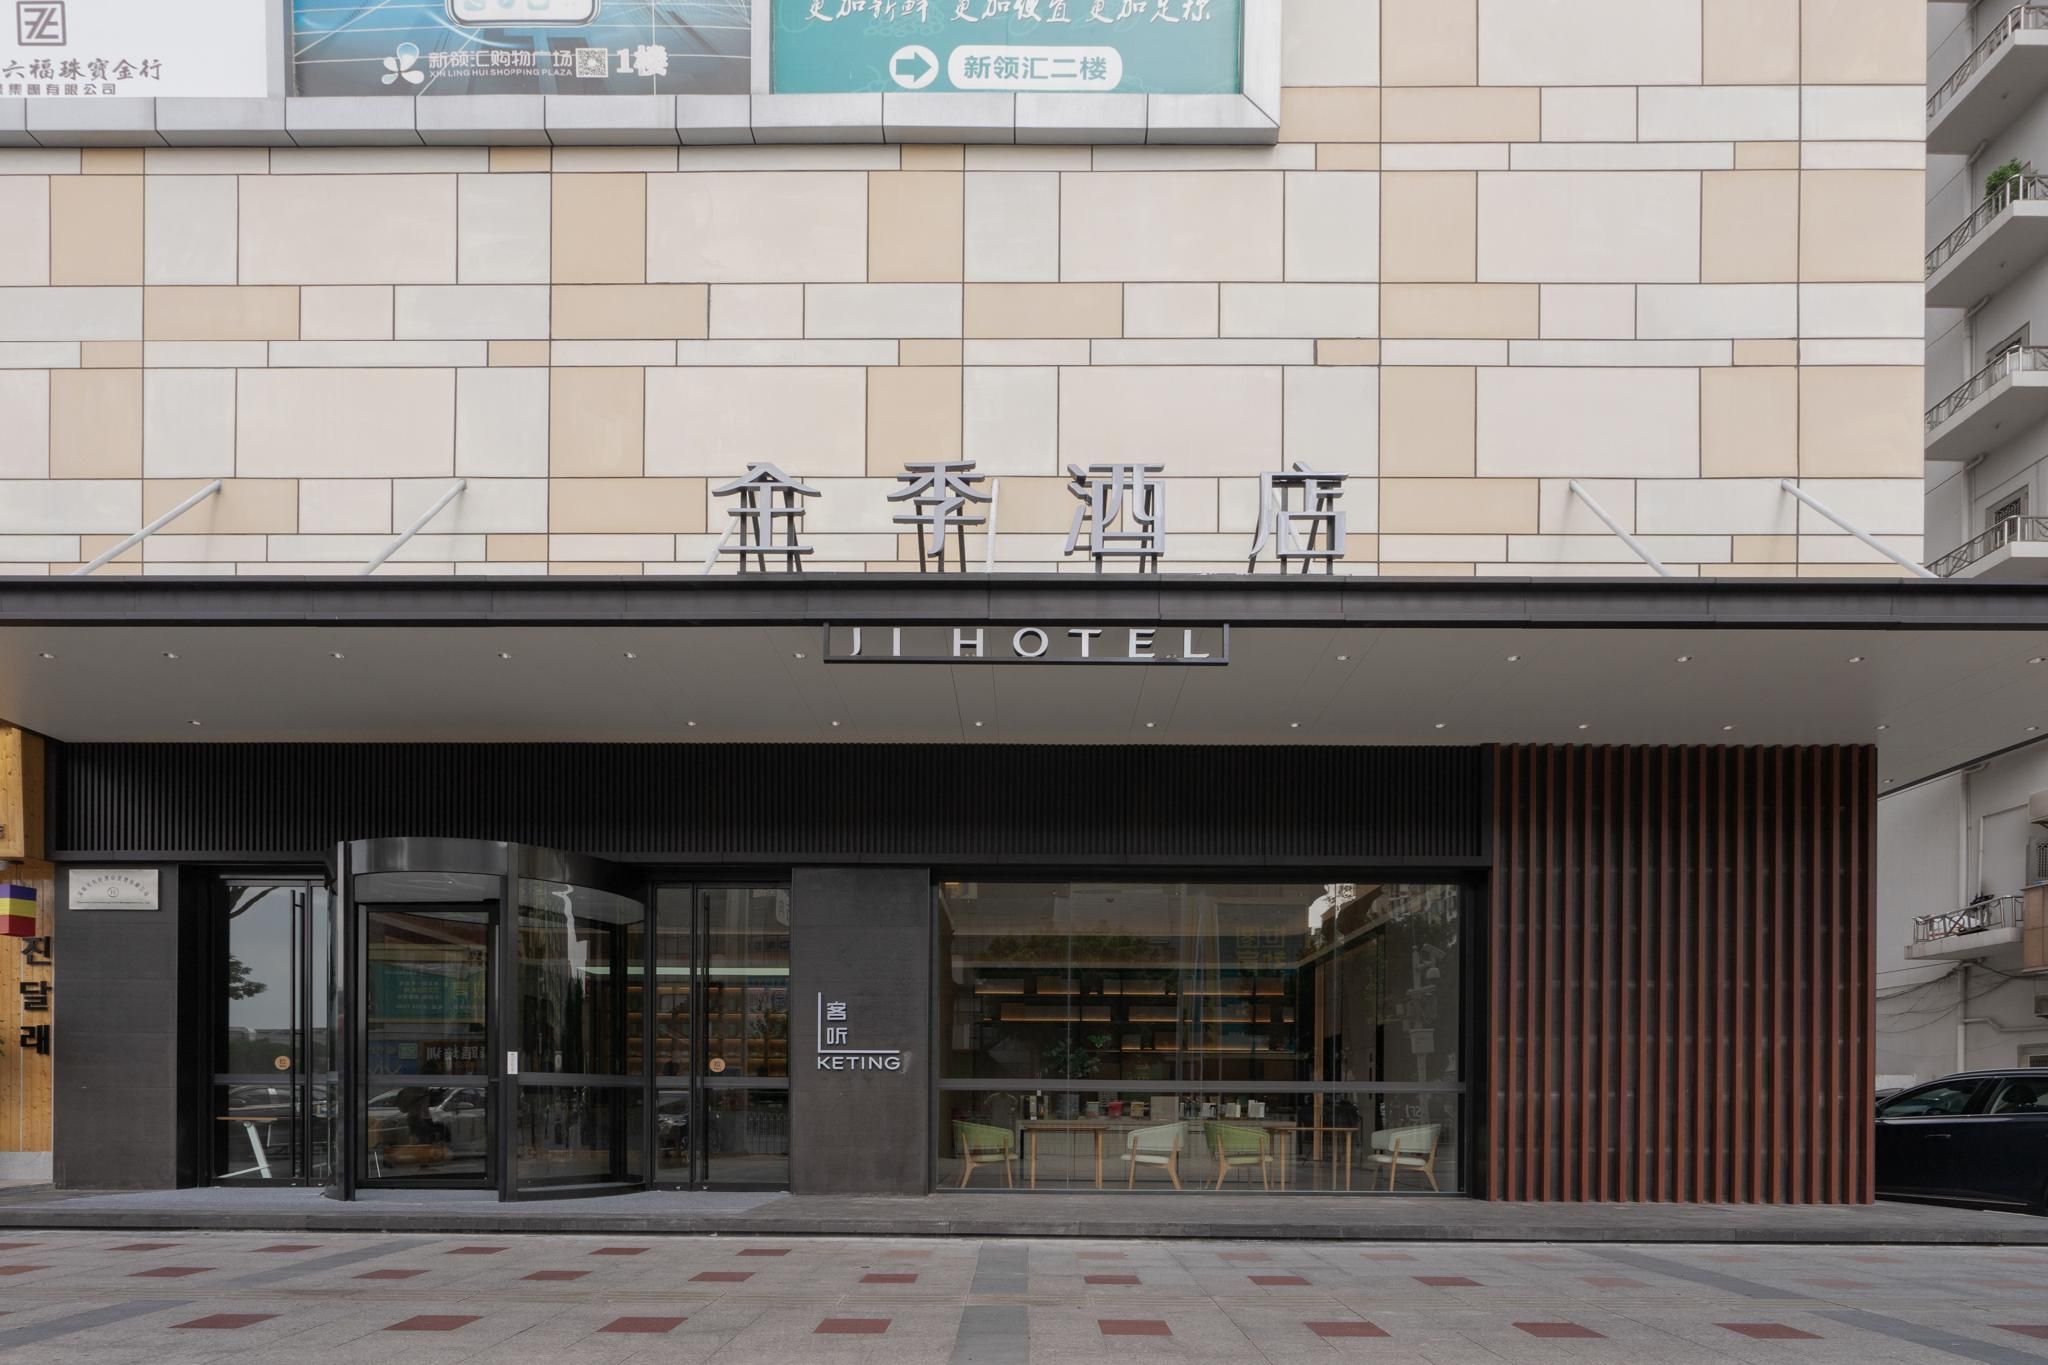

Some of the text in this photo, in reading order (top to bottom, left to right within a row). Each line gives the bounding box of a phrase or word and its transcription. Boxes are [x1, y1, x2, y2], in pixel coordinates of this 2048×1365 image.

[2, 58, 163, 80] 六福珠寶金行
[448, 69, 470, 77] LING
[490, 68, 540, 76] SHOPPING
[542, 68, 573, 76] PLAZA
[963, 55, 1108, 81] 新领汇二楼
[0, 83, 116, 95] 集團有限公司
[711, 460, 1348, 560] 全季酒店
[849, 627, 1210, 658] JI HOTEL
[817, 1056, 901, 1070] KETING
